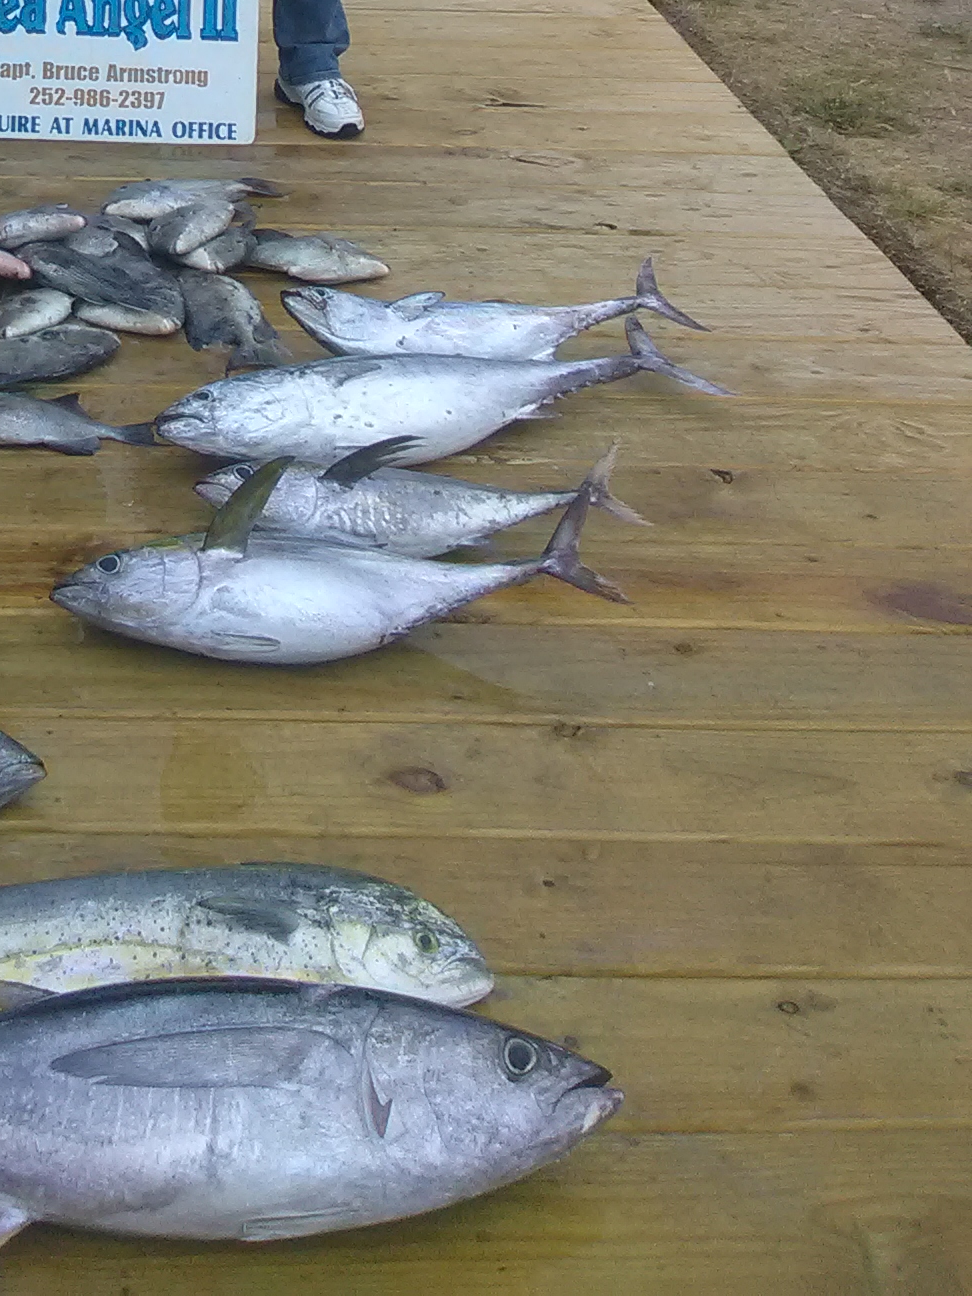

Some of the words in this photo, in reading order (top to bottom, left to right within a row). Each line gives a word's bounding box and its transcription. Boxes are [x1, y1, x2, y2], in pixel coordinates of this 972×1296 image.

[42, 61, 99, 82] Bruce
[106, 63, 209, 87] Armstrong
[29, 86, 165, 110] 252-986-2397
[49, 117, 74, 135] AT
[82, 117, 163, 138] MARINA
[171, 120, 238, 141] OFFICE
